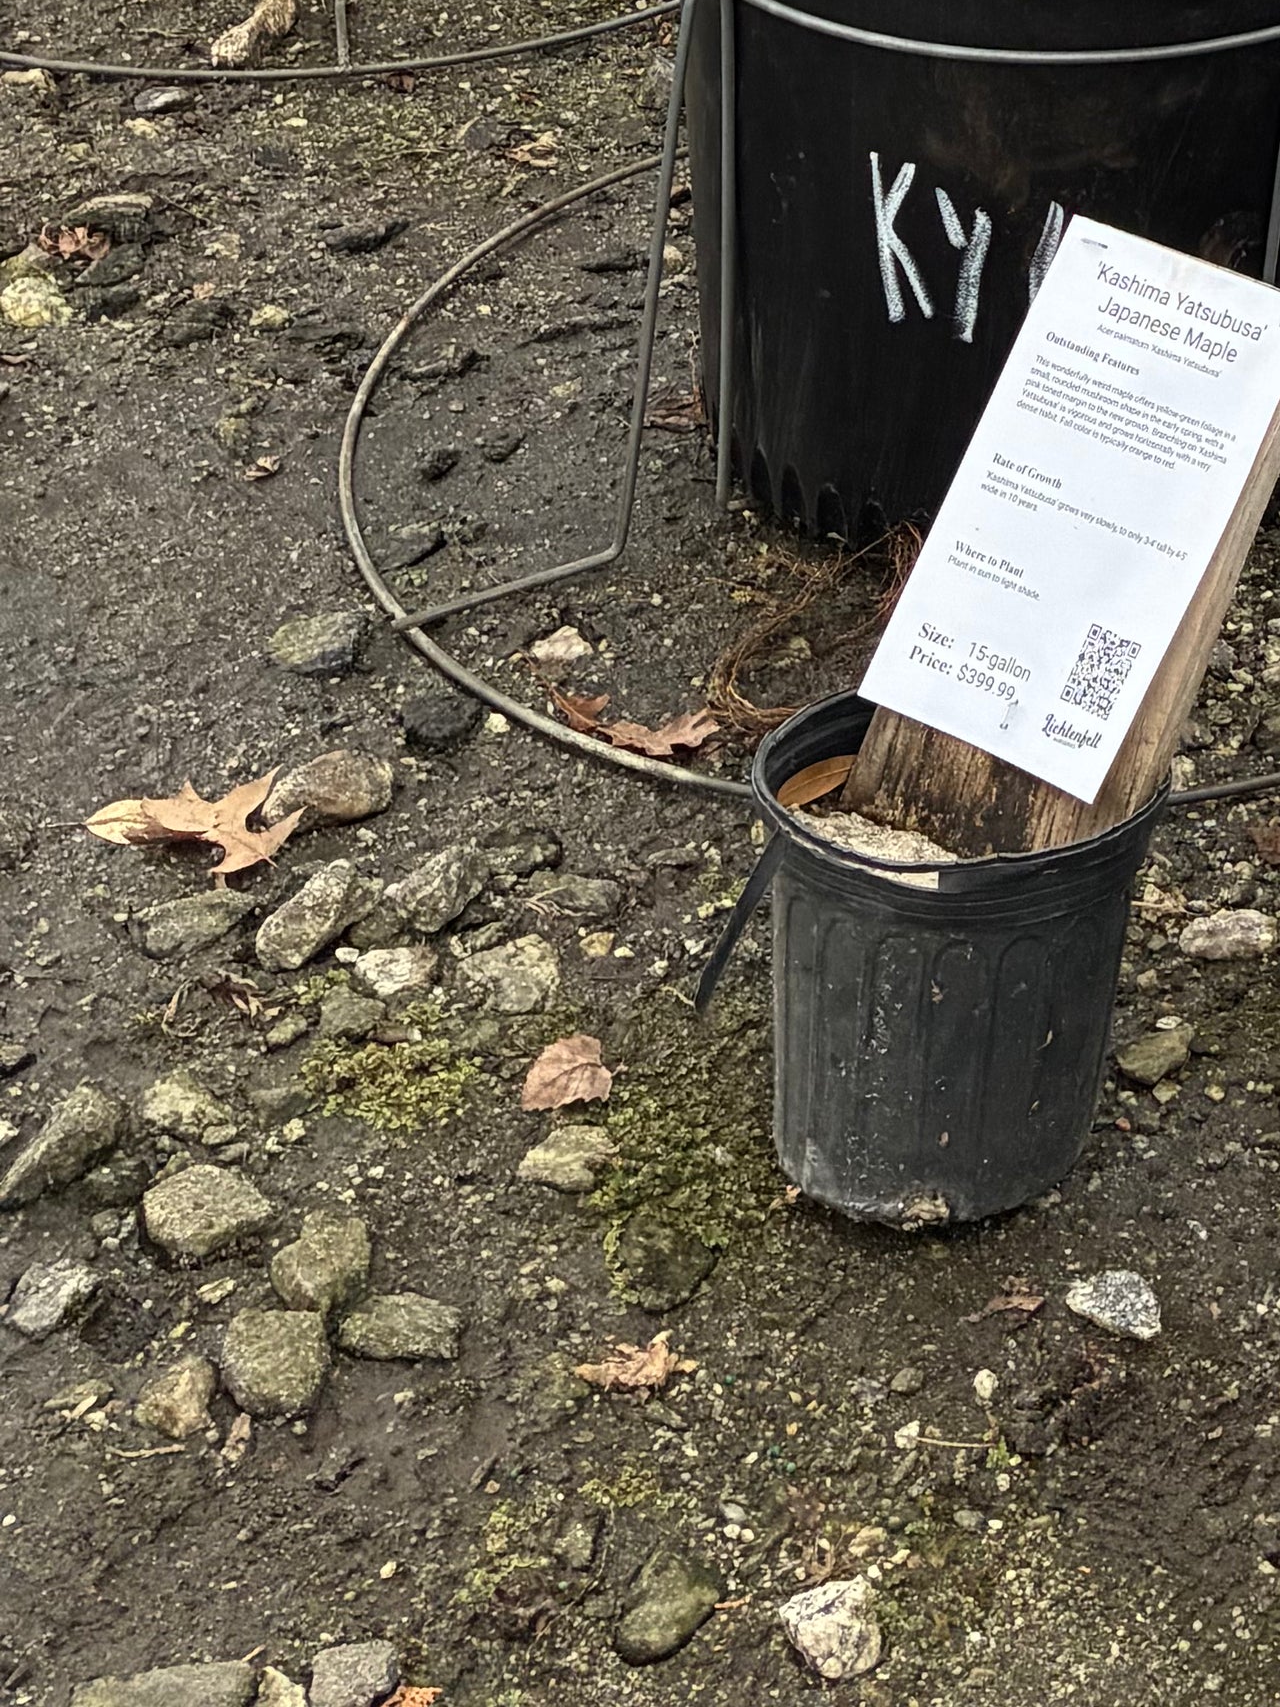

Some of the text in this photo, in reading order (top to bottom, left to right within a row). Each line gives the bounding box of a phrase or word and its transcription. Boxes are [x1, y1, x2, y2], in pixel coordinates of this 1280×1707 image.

[868, 151, 993, 343] KY
[1096, 260, 1269, 342] 'Kashima Yatsubusa'
[1045, 331, 1140, 376] Outstanding Features
[1097, 296, 1238, 363] Japanese Maple
[980, 483, 999, 496] wide
[998, 489, 1008, 500] in
[1007, 492, 1019, 503] 10
[992, 452, 1062, 490] Rate of Growth
[947, 554, 970, 571] Plant
[968, 564, 977, 574] in
[976, 568, 992, 580] sun
[991, 573, 1001, 583] to
[1000, 576, 1018, 591] light
[955, 540, 1024, 579] Where to Plant
[908, 645, 1016, 701] Price: $399.99
[918, 622, 1032, 683] Size: 15-gallon
